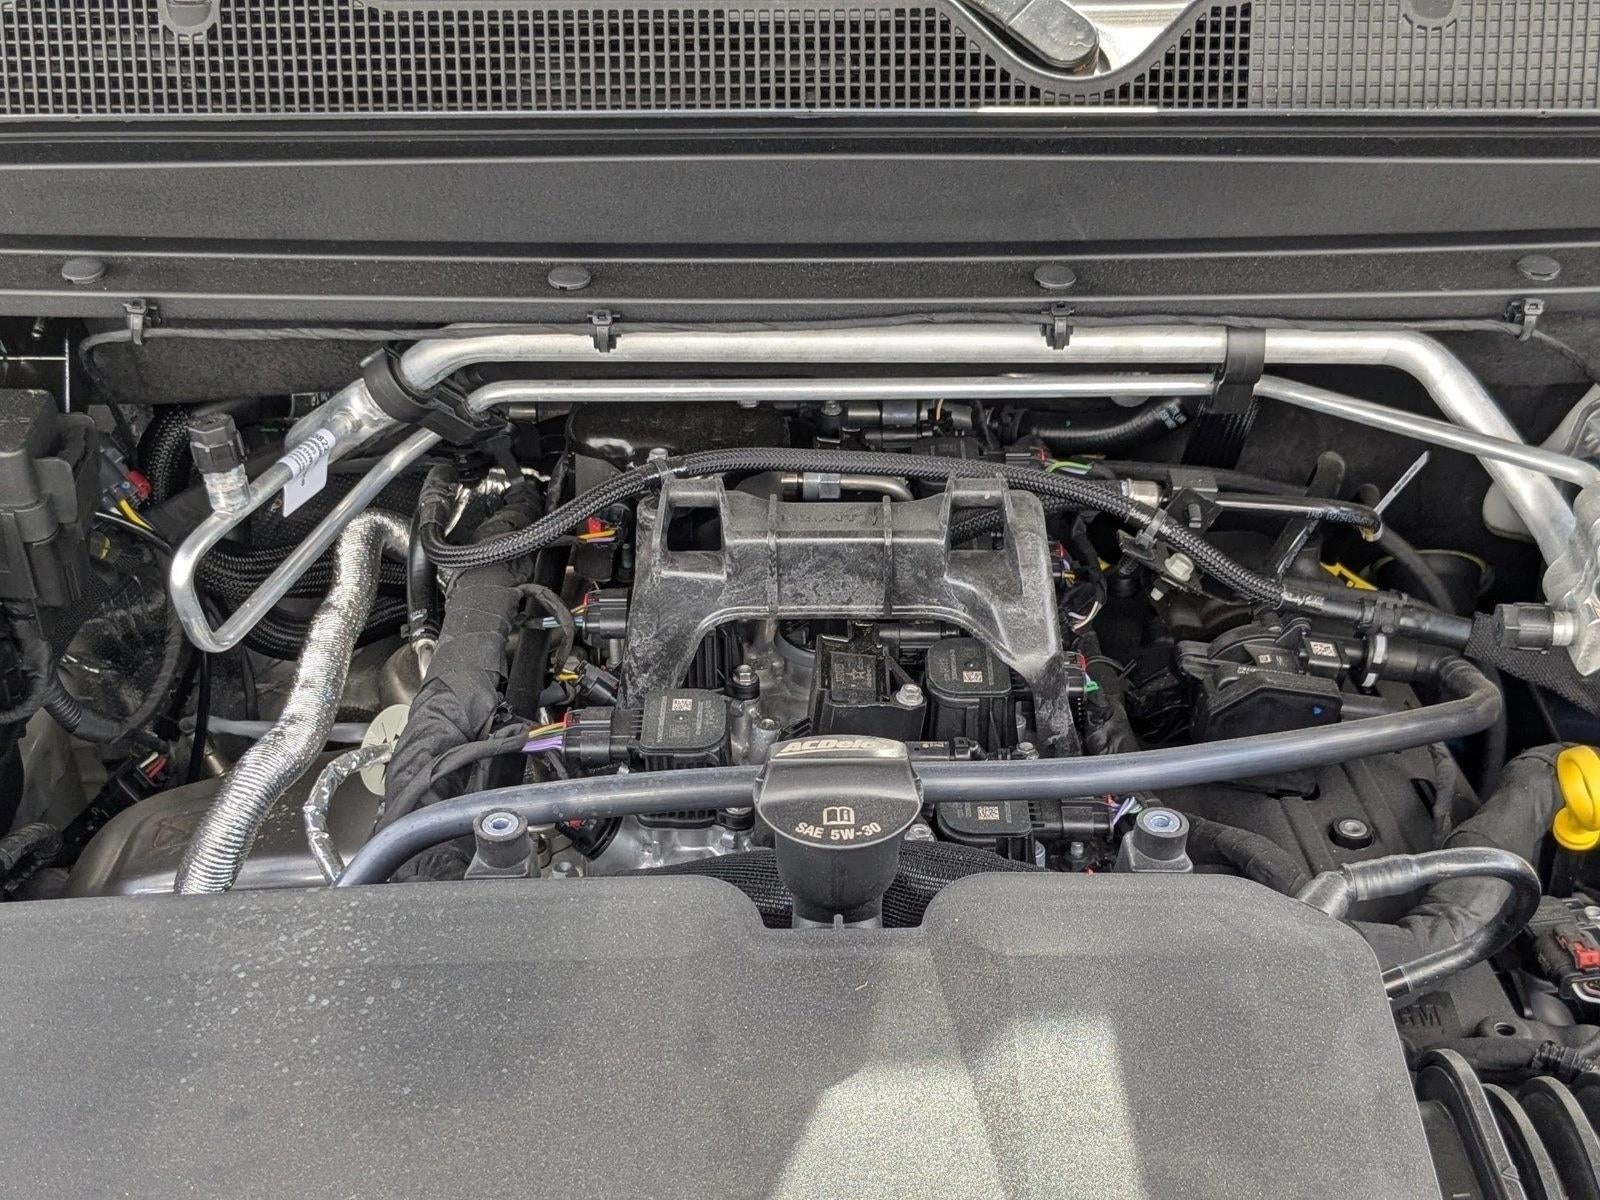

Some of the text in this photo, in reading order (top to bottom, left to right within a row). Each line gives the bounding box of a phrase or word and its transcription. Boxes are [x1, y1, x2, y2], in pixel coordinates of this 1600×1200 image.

[780, 739, 888, 753] ACDelc
[795, 822, 881, 840] SAE 5W-30
